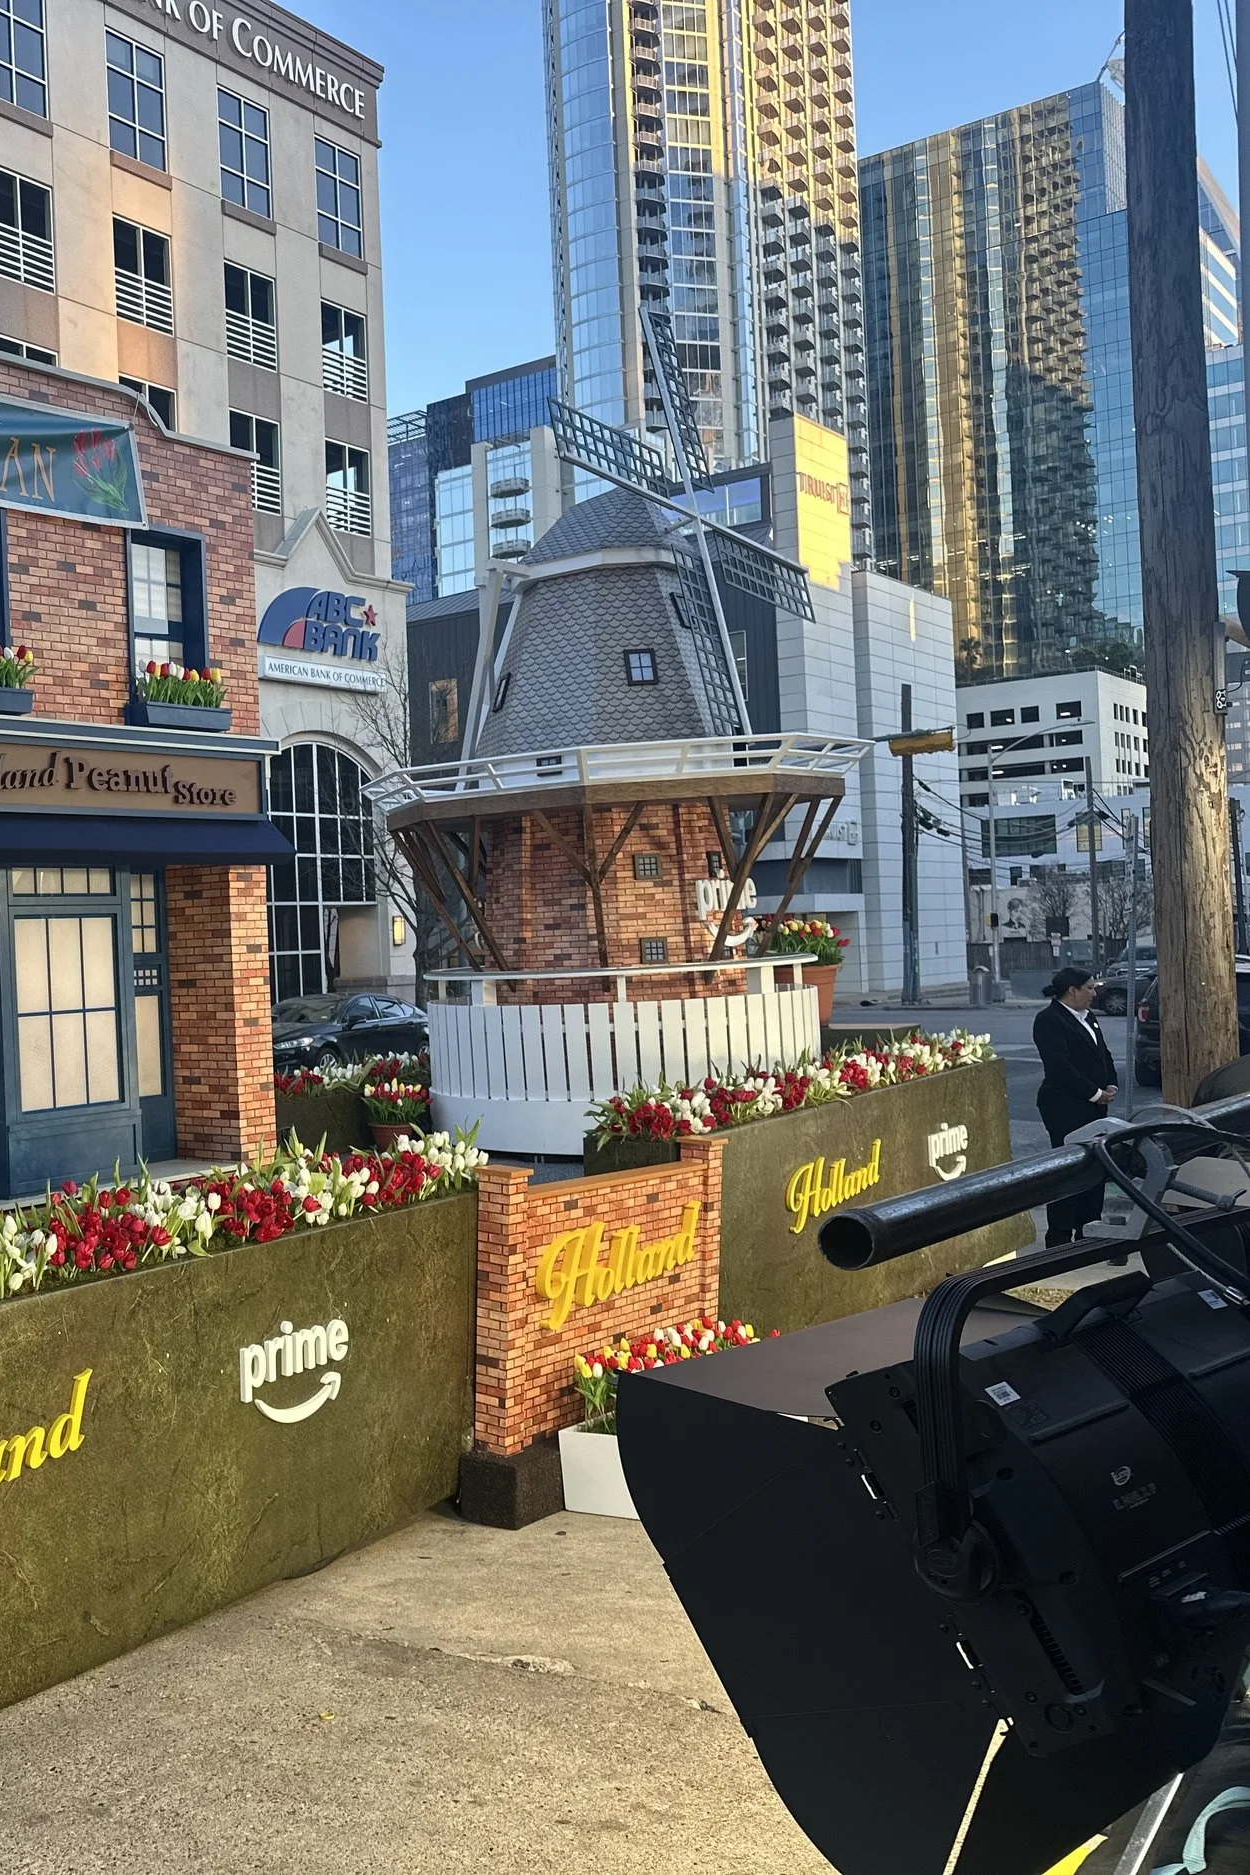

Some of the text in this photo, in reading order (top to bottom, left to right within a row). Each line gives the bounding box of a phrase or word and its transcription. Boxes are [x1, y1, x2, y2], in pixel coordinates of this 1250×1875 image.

[189, 0, 365, 119] OF COMMERCE
[799, 472, 837, 504] TRUIST
[306, 590, 366, 628] ABC
[303, 620, 380, 662] BANK
[268, 662, 386, 688] AMERICAN BANK OF COMMERCE
[64, 756, 173, 794] Peanut
[172, 779, 238, 806] Store
[927, 1122, 969, 1168] prime
[784, 1138, 882, 1234] Holland
[536, 1200, 702, 1332] Holland
[239, 1318, 349, 1403] prime
